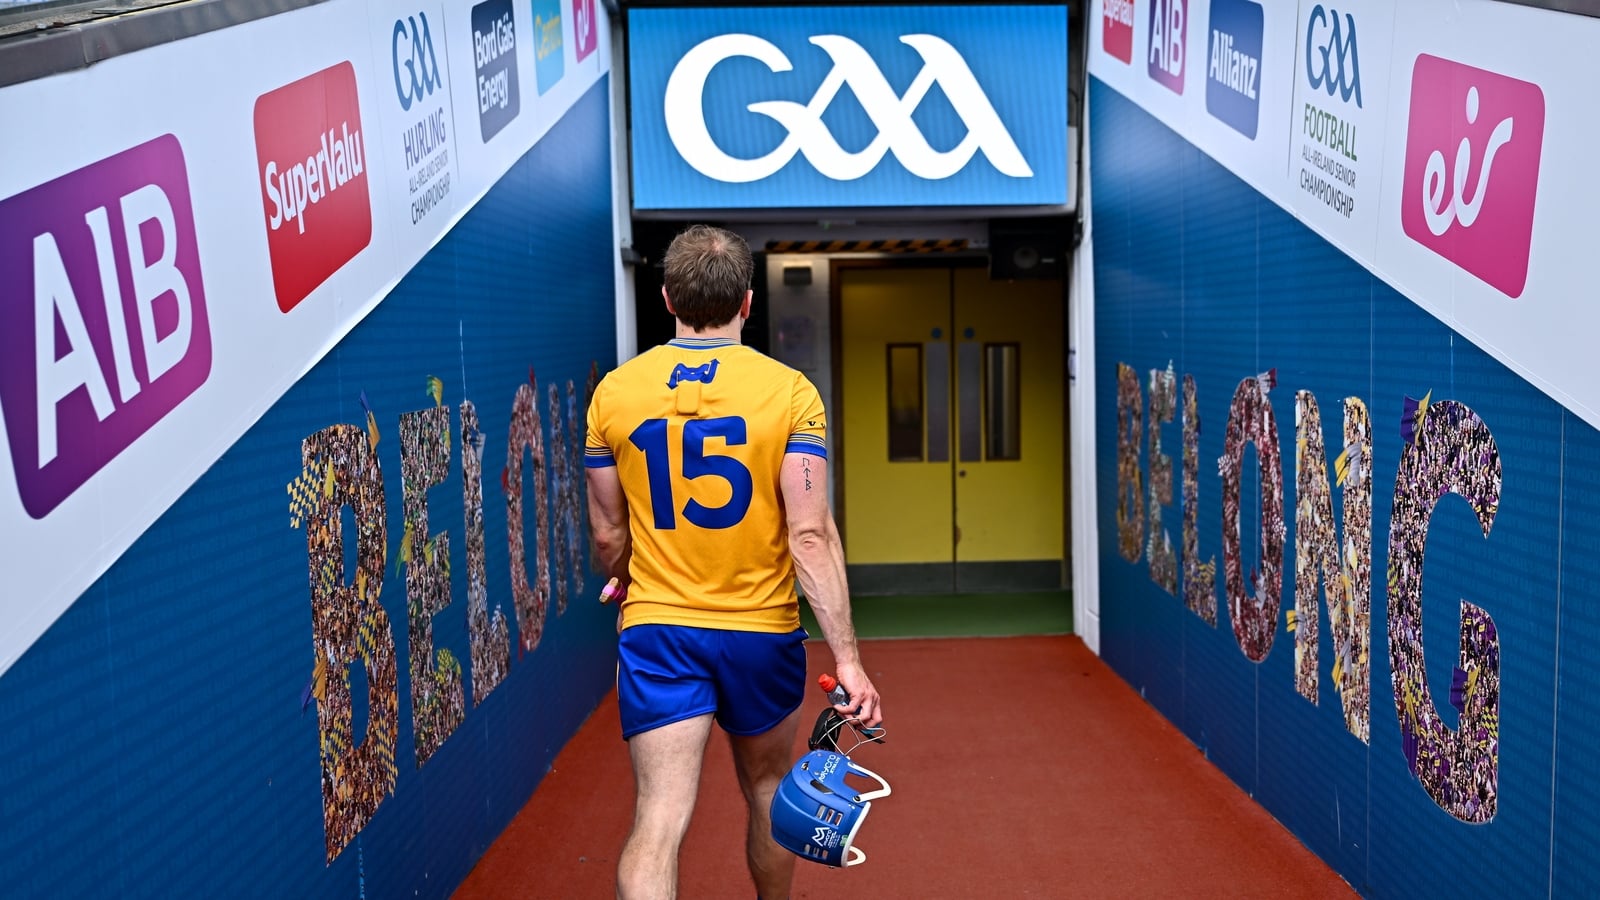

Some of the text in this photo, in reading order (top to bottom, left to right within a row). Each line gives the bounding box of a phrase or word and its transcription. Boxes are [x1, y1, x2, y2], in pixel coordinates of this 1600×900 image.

[392, 11, 442, 112] GAA
[474, 20, 498, 69] Bord
[1149, 0, 1184, 77] AIB
[1209, 29, 1257, 100] Allianz
[1306, 4, 1363, 109] GAA
[478, 67, 509, 114] Energy
[664, 33, 1034, 183] GAA
[403, 107, 446, 170] HURLING
[1302, 144, 1356, 189] ALL-IRELAND SENIOR
[1303, 103, 1357, 161] FOOTBALL
[1422, 86, 1514, 236] eir
[264, 121, 363, 234] SuperValu
[409, 161, 435, 196] ALL-IRELAND
[411, 171, 451, 225] CHAMPIONSHIP
[1300, 167, 1354, 219] CHAMPIONSHIP
[33, 184, 193, 470] AIB
[628, 415, 754, 530] 15
[1116, 361, 1502, 825] BELONG
